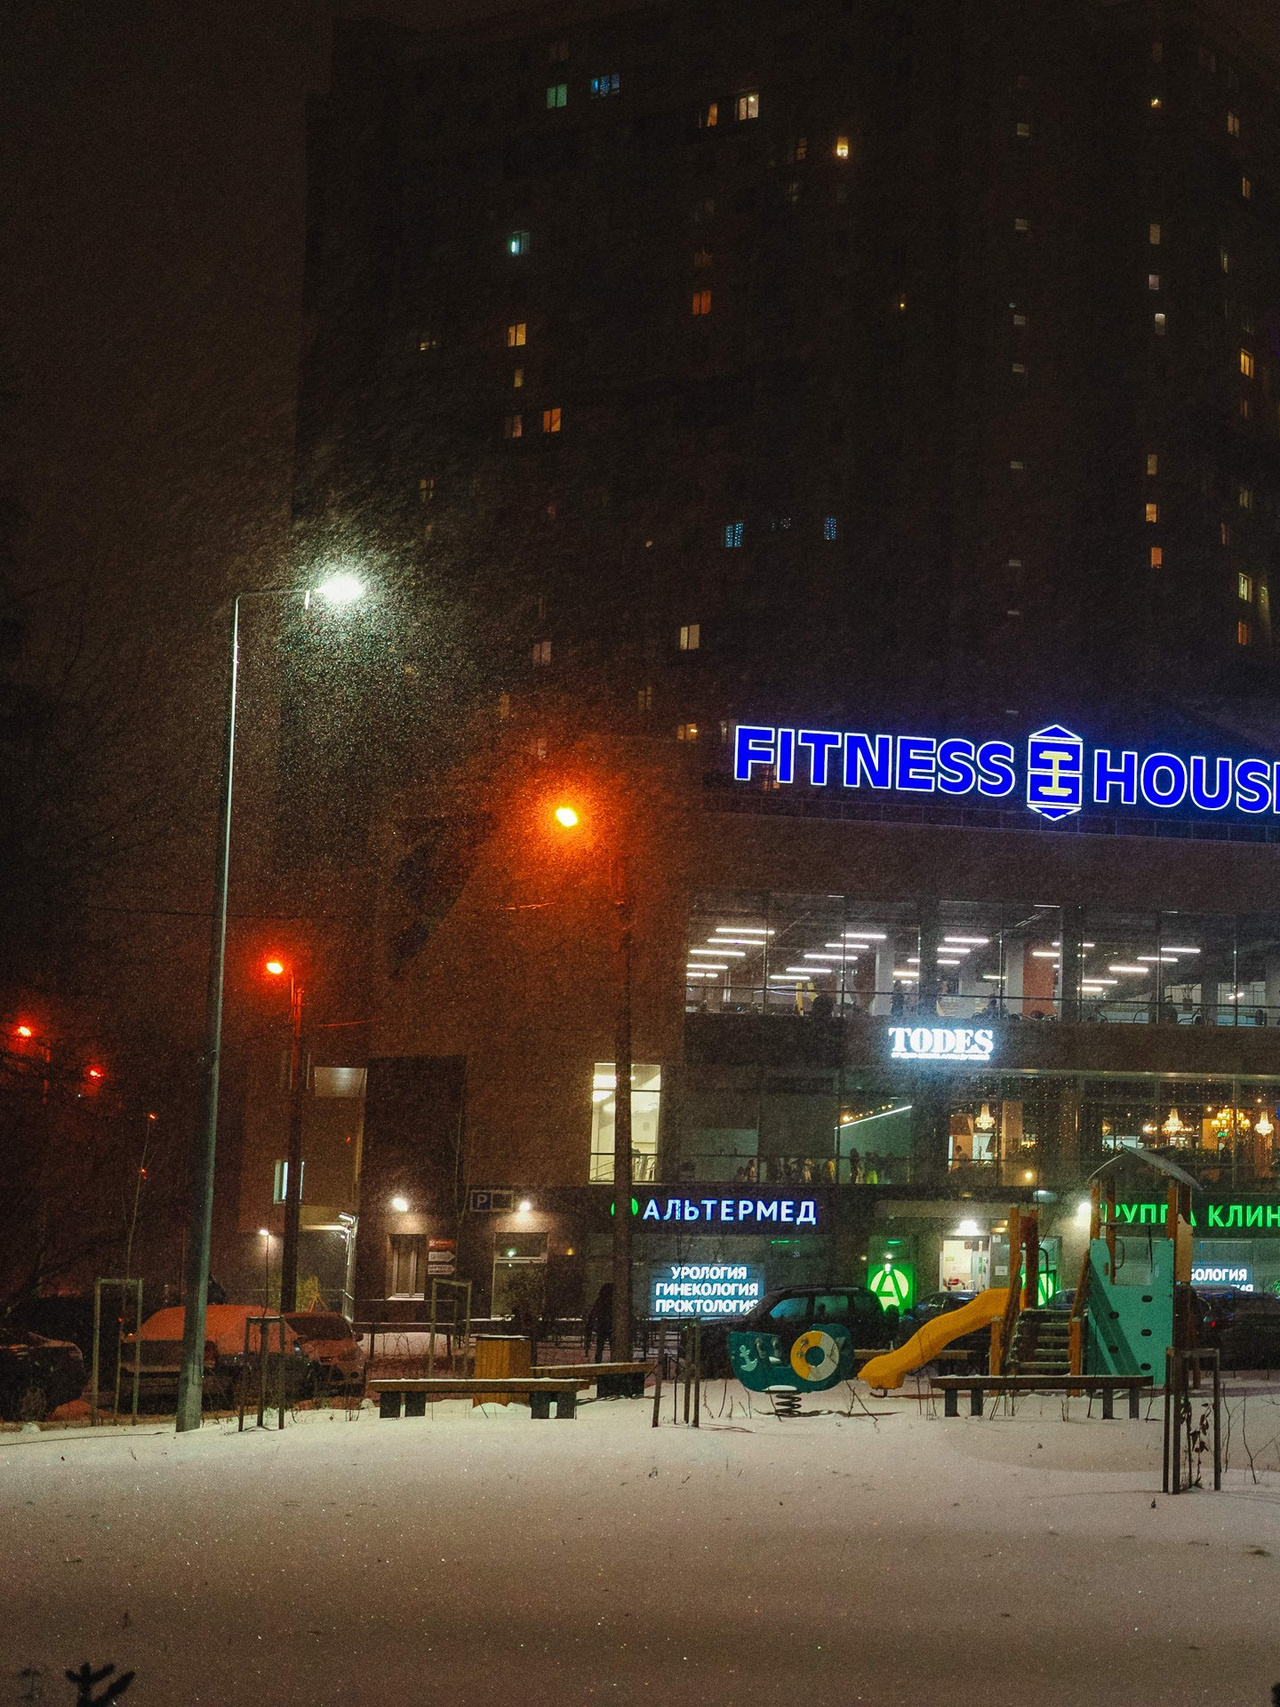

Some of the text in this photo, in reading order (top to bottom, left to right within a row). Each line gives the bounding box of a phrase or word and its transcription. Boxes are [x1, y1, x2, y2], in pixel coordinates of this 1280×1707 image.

[734, 724, 1014, 797] FITNESS
[888, 1027, 994, 1054] TODES
[643, 1199, 817, 1225] АЛЬТЕРМЕД
[671, 1266, 747, 1280] УРОЛОГИЯ
[655, 1283, 759, 1296] ГИНЕКОЛОГИЯ
